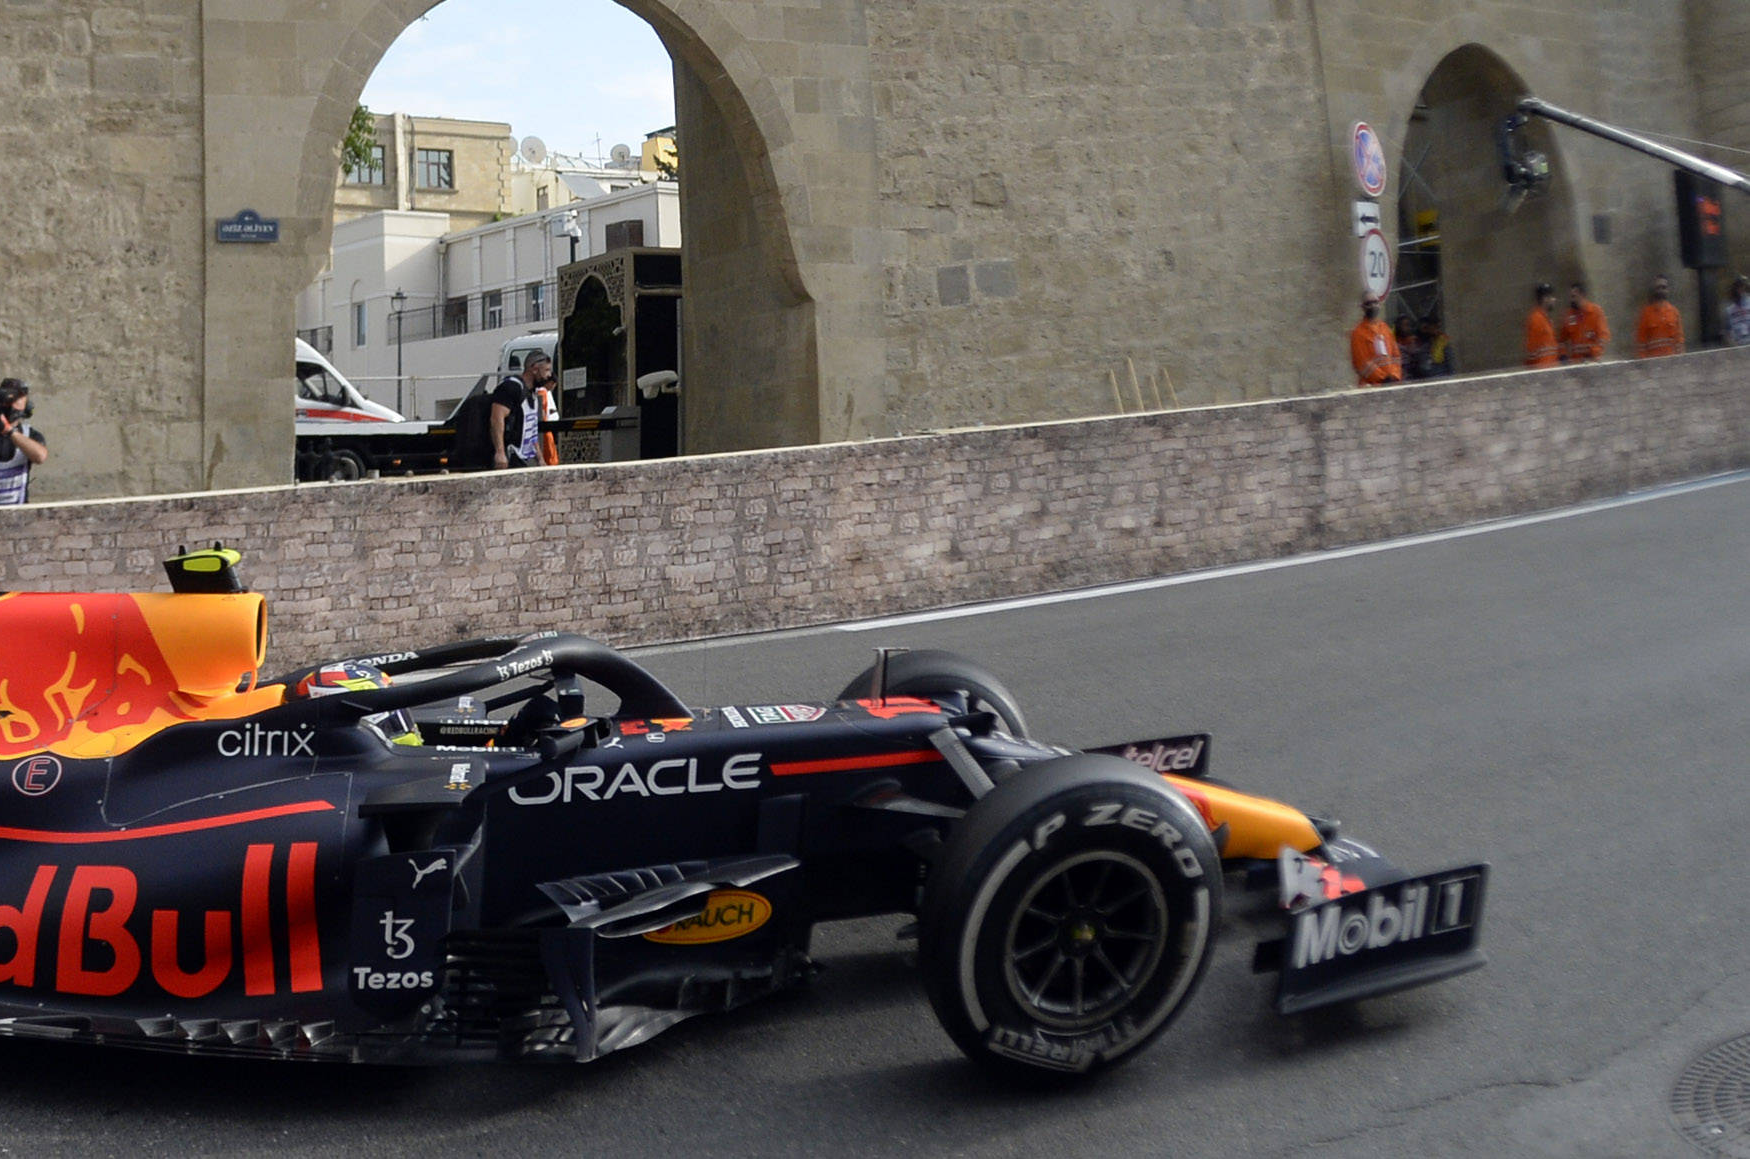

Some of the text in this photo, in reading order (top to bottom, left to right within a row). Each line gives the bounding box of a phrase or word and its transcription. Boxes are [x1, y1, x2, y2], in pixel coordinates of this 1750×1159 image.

[1369, 251, 1386, 278] 20
[357, 651, 419, 667] ONDA
[509, 656, 542, 676] Tezos
[217, 723, 315, 757] citrix
[508, 753, 762, 805] ORACLE
[1034, 803, 1204, 879] P ZERO
[1292, 882, 1464, 969] Mobil 1
[353, 966, 434, 990] Tezos
